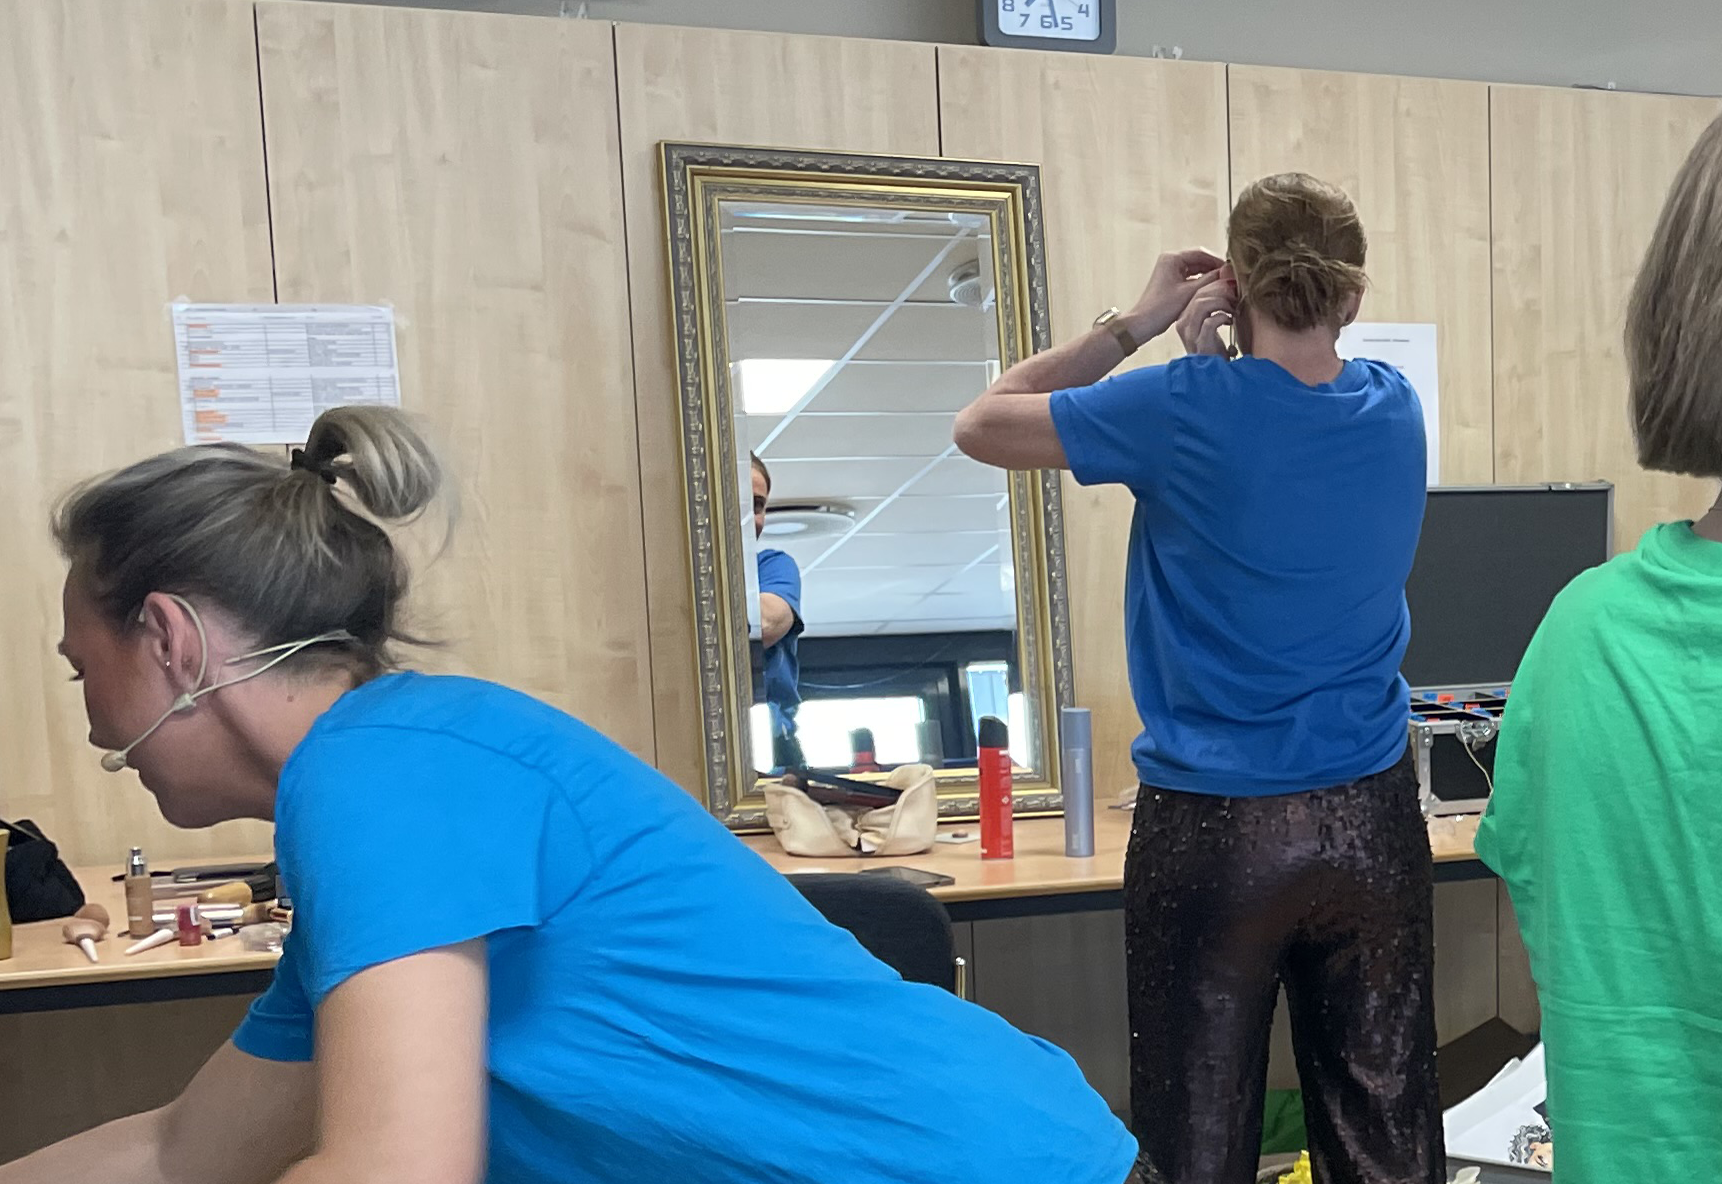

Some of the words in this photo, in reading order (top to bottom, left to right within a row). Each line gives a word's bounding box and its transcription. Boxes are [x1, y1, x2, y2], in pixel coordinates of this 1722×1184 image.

[1077, 4, 1090, 18] 4
[1019, 13, 1031, 28] 7
[1040, 15, 1053, 29] 6
[1061, 16, 1073, 31] 5
